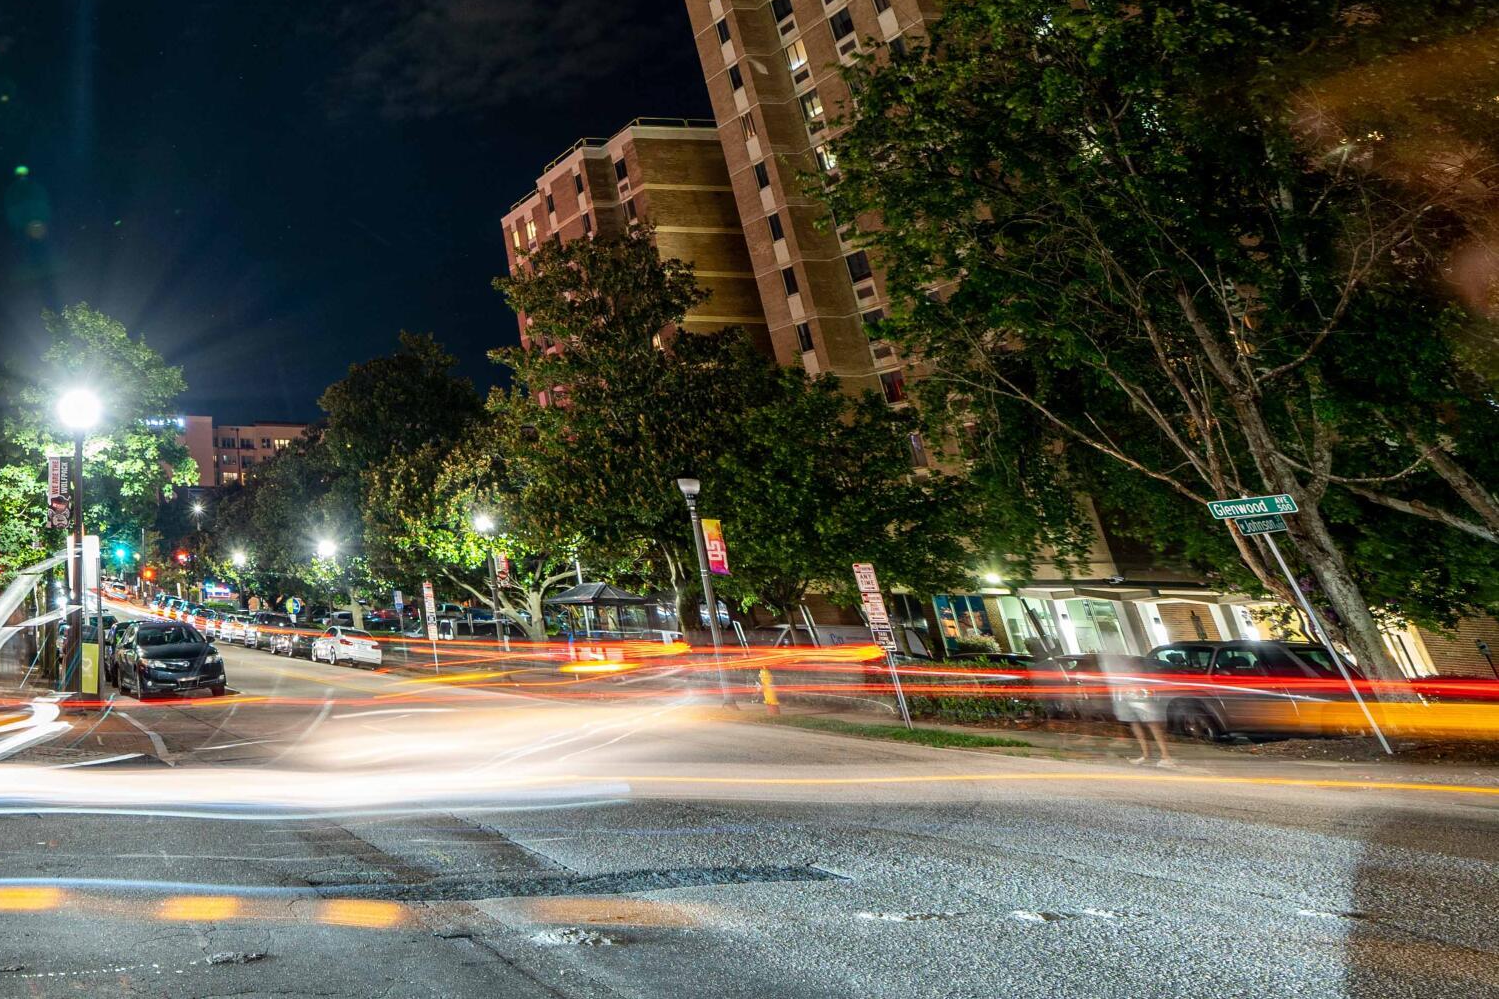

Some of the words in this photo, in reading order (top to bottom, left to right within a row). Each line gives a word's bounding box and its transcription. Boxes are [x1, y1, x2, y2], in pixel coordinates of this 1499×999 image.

[52, 486, 59, 494] WE
[1213, 500, 1268, 516] Glenwood
[1276, 503, 1293, 511] 500
[1245, 519, 1276, 533] Johnson
